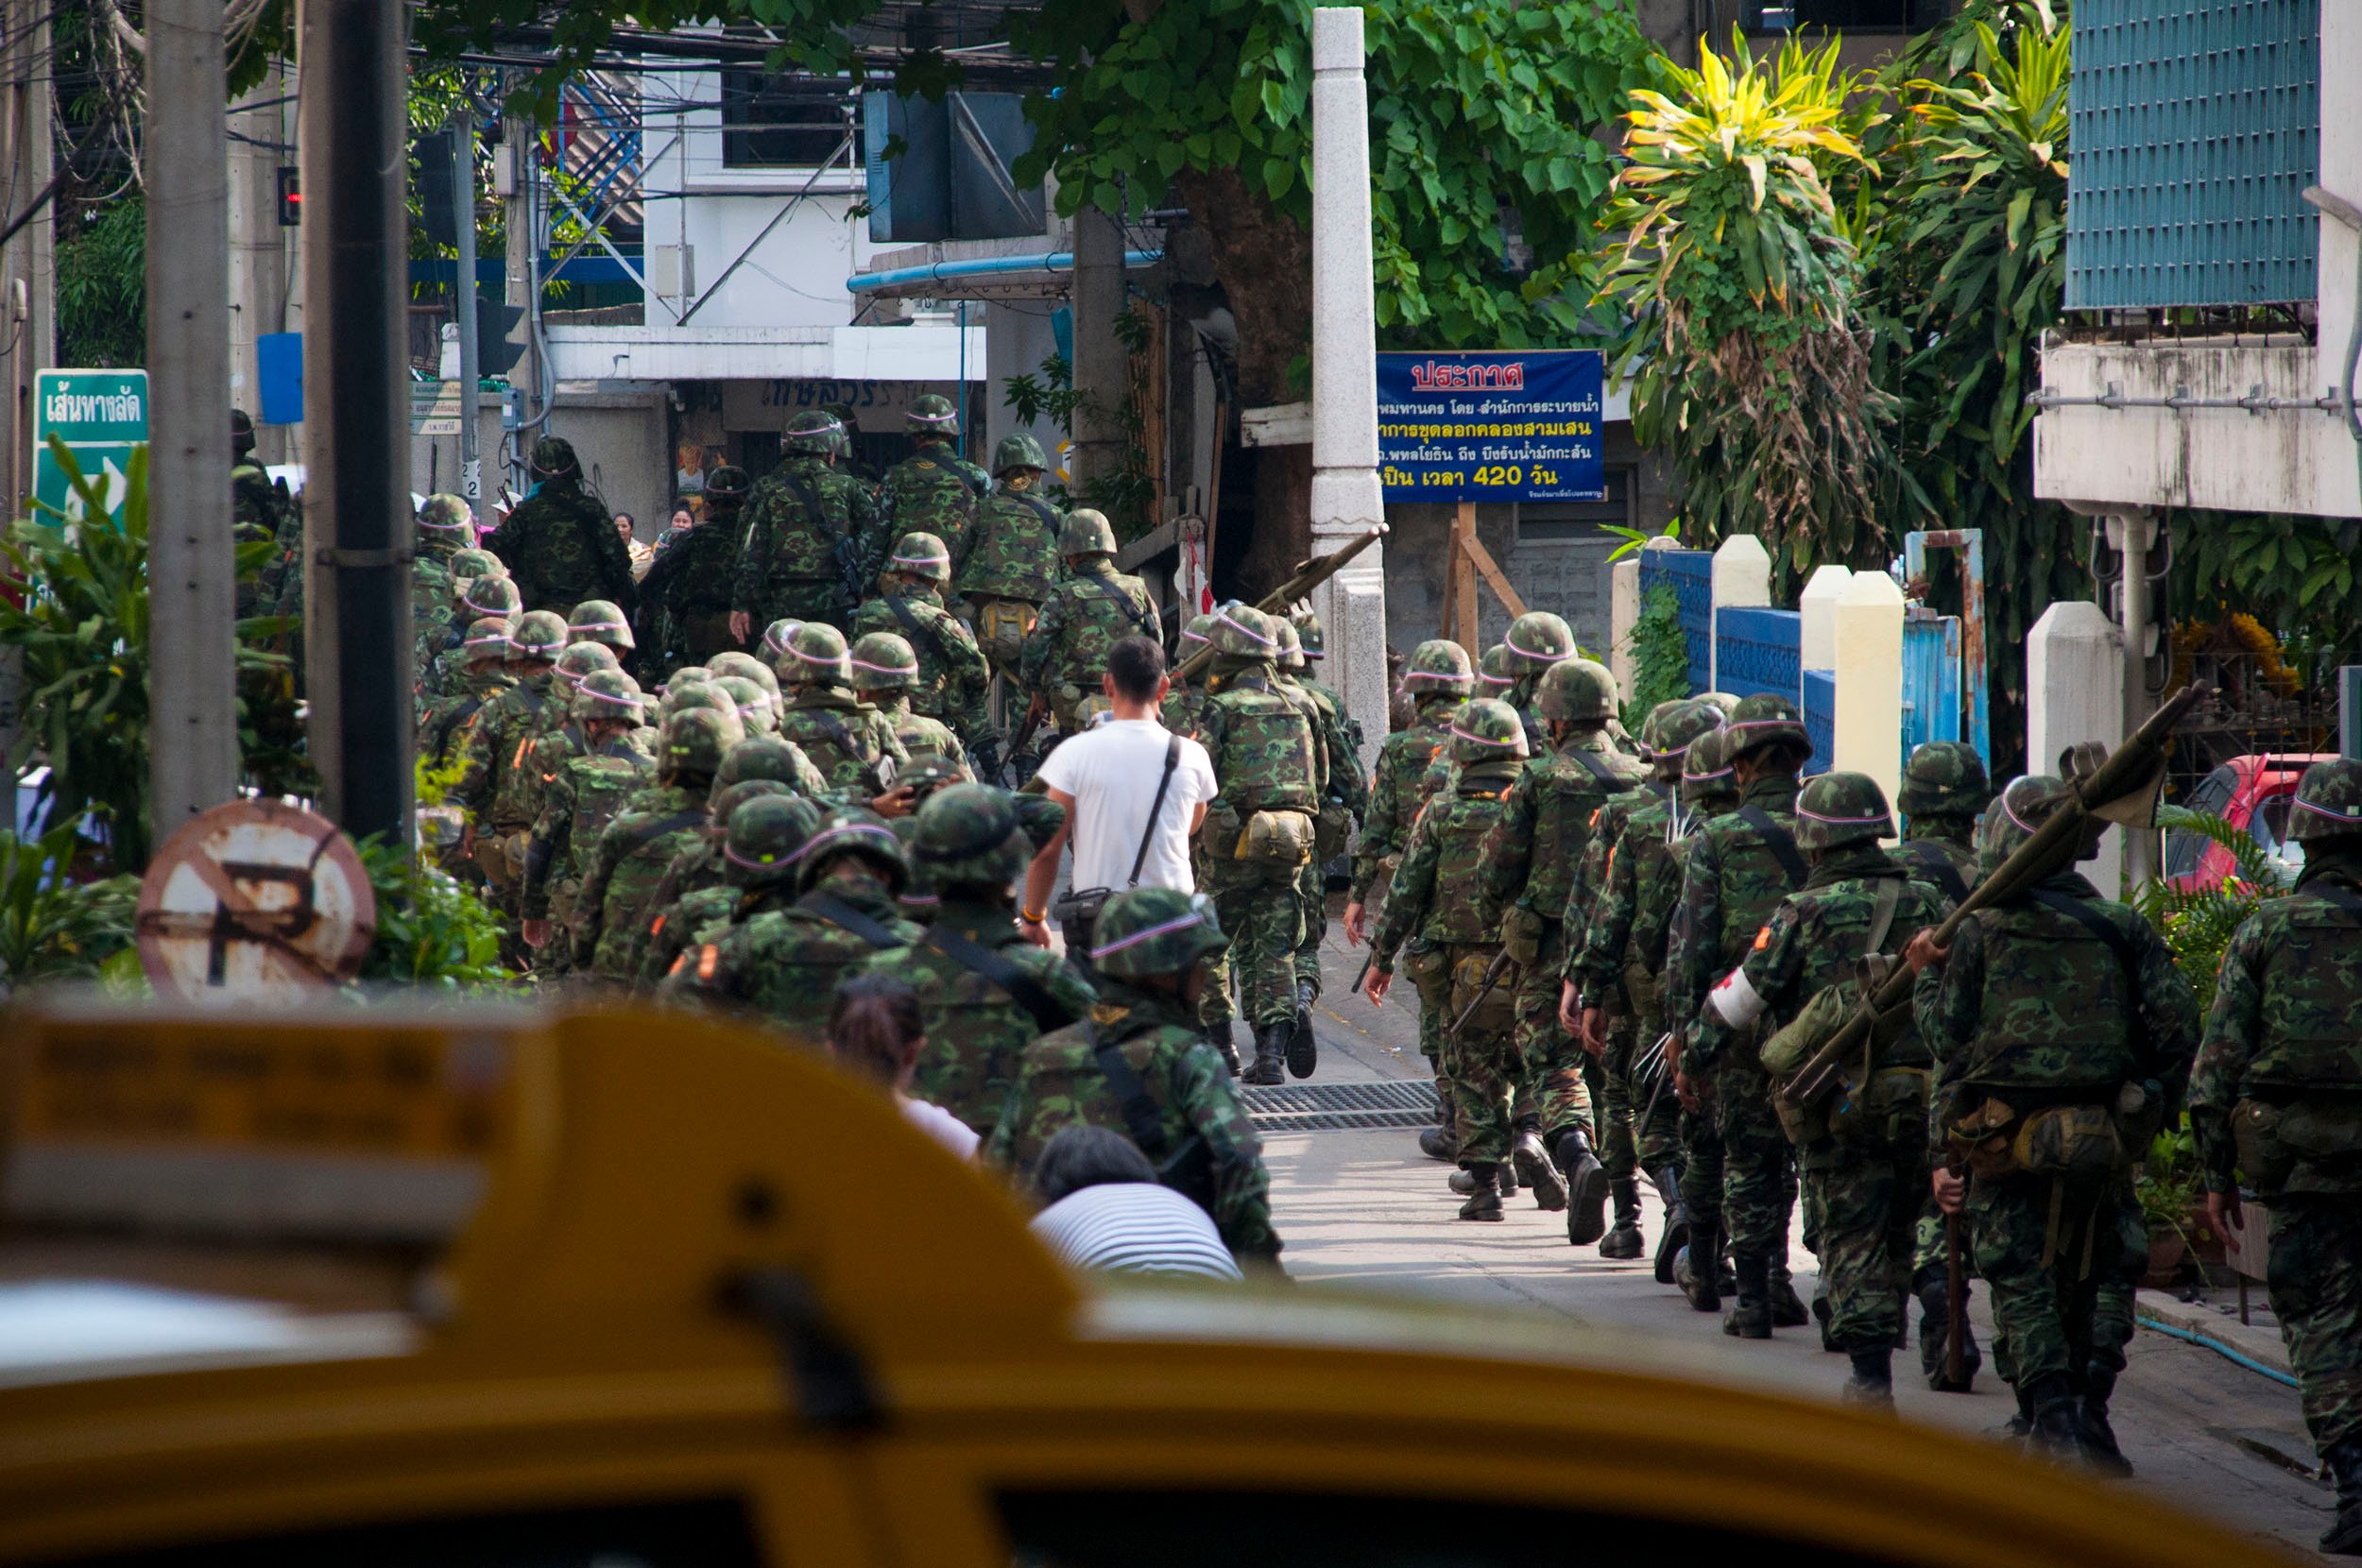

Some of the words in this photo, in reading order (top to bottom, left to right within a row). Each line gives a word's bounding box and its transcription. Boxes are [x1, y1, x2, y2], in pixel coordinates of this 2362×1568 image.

[1412, 360, 1523, 386] ประกาศ
[47, 381, 141, 422] เส้นทางลัด
[1449, 400, 1474, 415] โดย
[1481, 393, 1599, 415] สำนักการระบายน้ำ
[1458, 446, 1476, 461] ถึง
[1481, 440, 1592, 461] บึงรับน้ำมักกะสัน
[1422, 471, 1464, 486] เวลา
[1473, 466, 1522, 486] 420
[1530, 465, 1558, 486] วัน
[469, 481, 477, 496] 2
